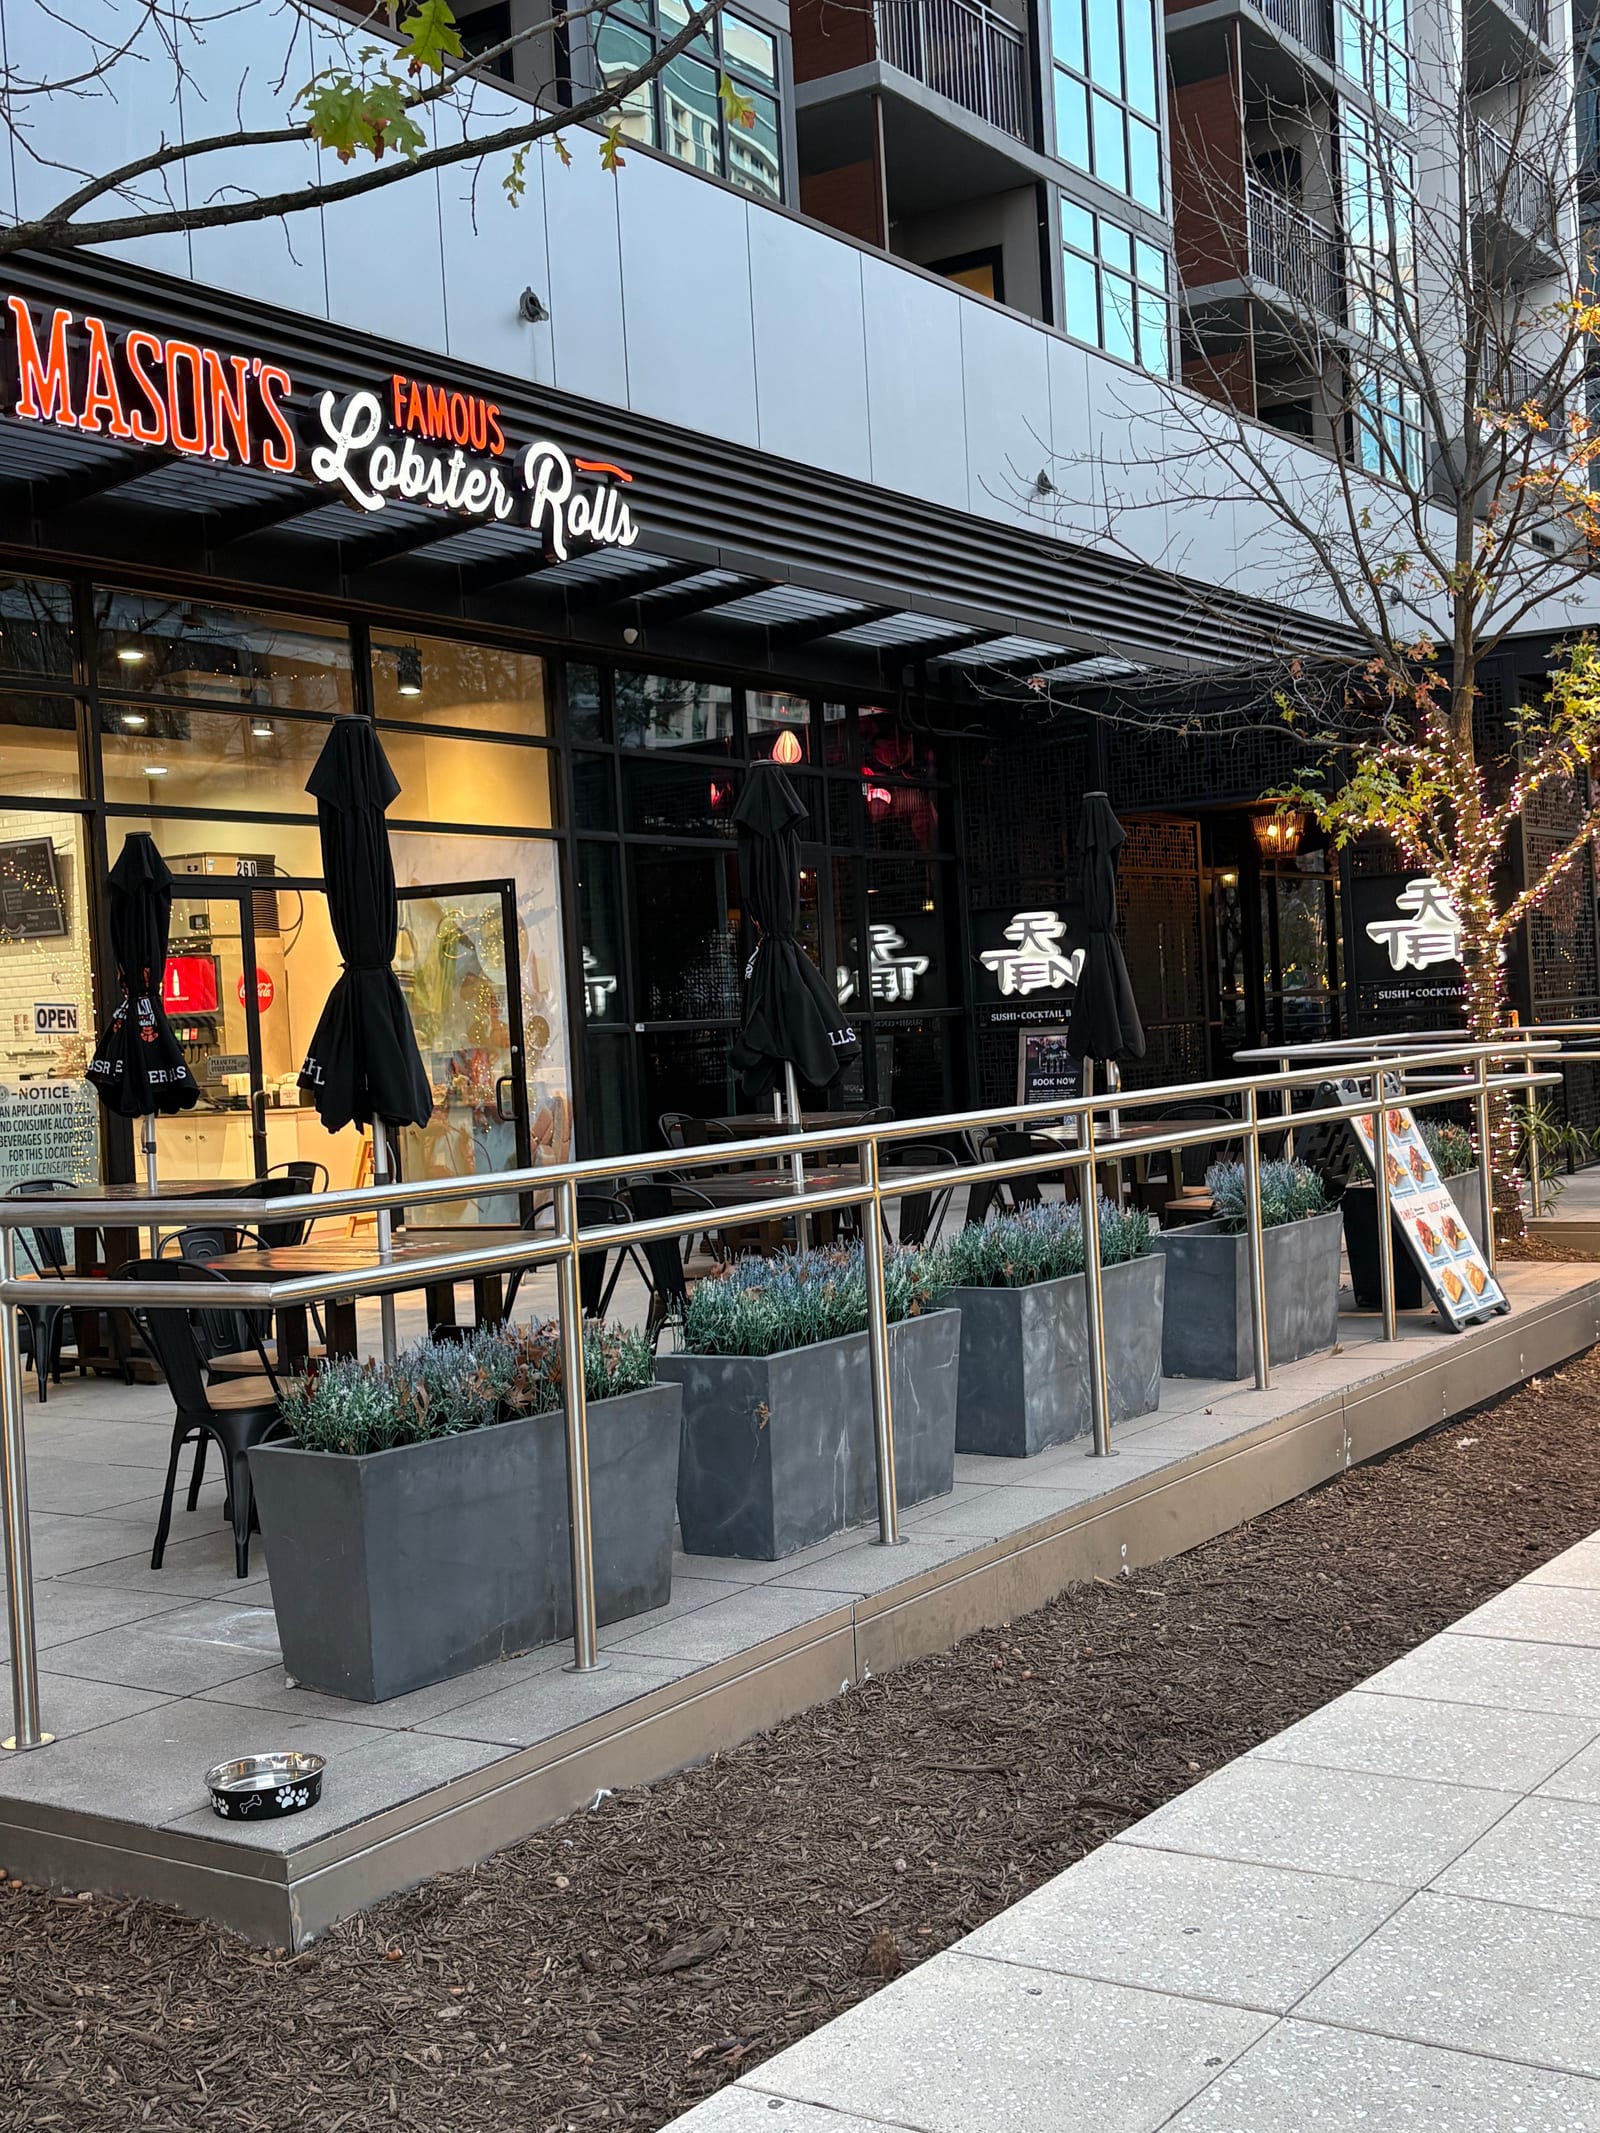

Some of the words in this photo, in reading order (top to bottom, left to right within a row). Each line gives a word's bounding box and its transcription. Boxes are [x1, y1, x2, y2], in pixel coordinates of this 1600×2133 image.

[8, 296, 297, 473] MASON'S
[392, 375, 505, 456] FAMOUS
[311, 391, 513, 521] Lobster
[516, 441, 639, 562] Rolls
[236, 861, 257, 876] 260
[979, 948, 1086, 995] TEN
[36, 1008, 77, 1028] OPEN
[1032, 1078, 1055, 1087] BOOK
[1056, 1076, 1076, 1086] NOW
[12, 1103, 62, 1117] APPLICATION
[63, 1102, 73, 1115] TO
[0, 1120, 12, 1133] ND
[13, 1118, 52, 1132] CONSUME
[44, 1132, 52, 1145] IS
[53, 1130, 93, 1144] PROPOSED
[9, 1149, 24, 1162] FOR
[25, 1148, 43, 1161] THIS
[1, 1164, 19, 1178] TYPE
[21, 1163, 30, 1176] OF
